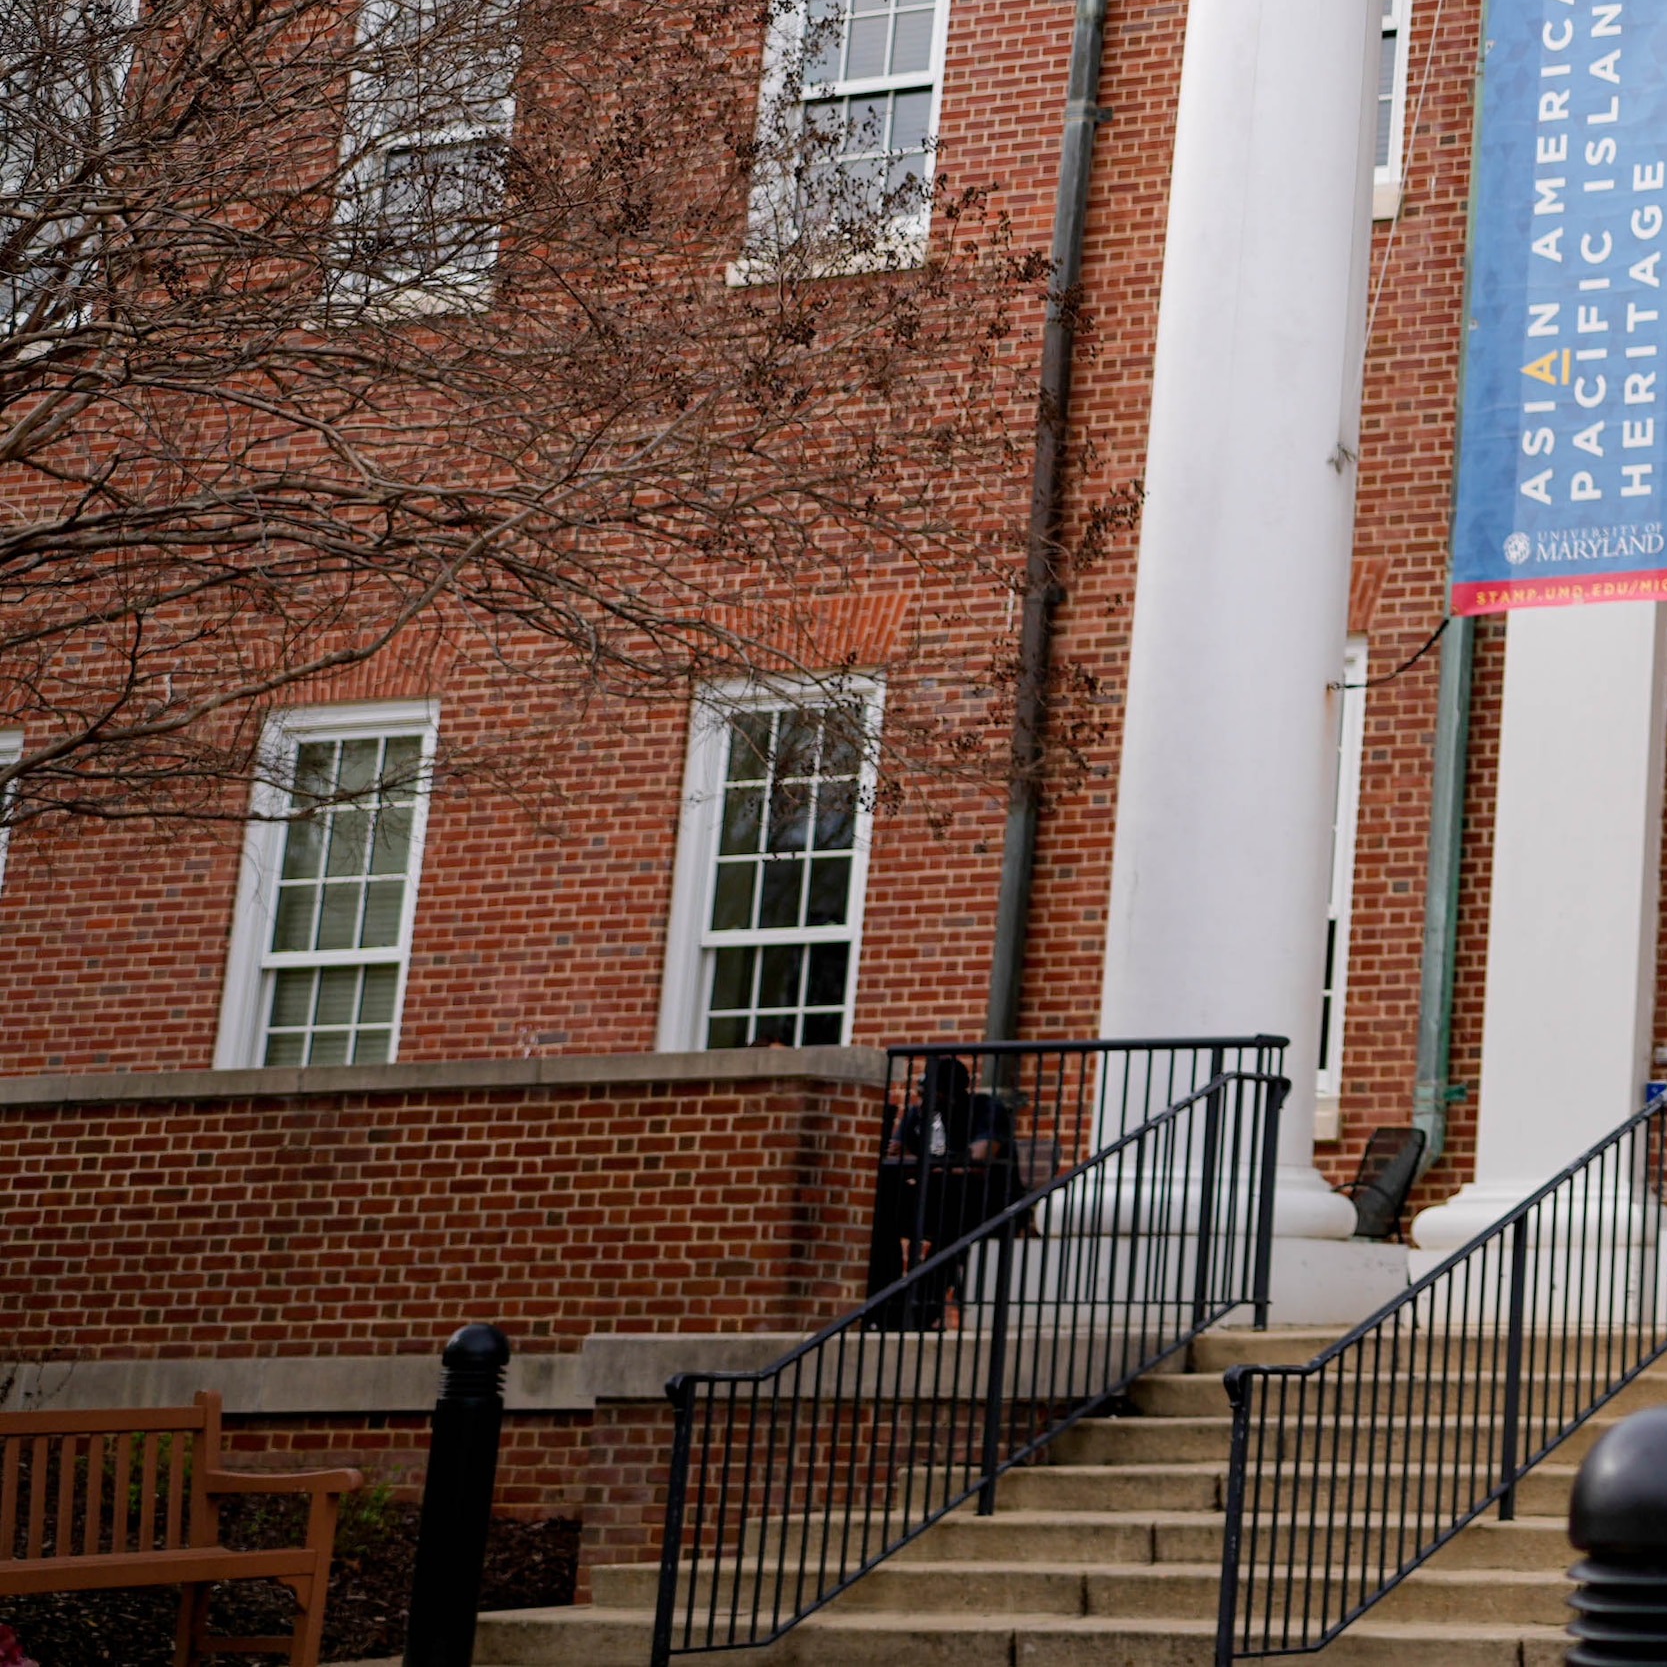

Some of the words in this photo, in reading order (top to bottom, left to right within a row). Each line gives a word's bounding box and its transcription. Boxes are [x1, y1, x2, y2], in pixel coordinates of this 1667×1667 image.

[1520, 302, 1561, 506] ASIAN
[1570, 229, 1613, 502] PACIFIC
[1620, 160, 1664, 498] HERITAGE
[1536, 533, 1665, 563] MARYLAND
[1537, 523, 1639, 542] UNIVERSITY
[1645, 521, 1662, 533] OF
